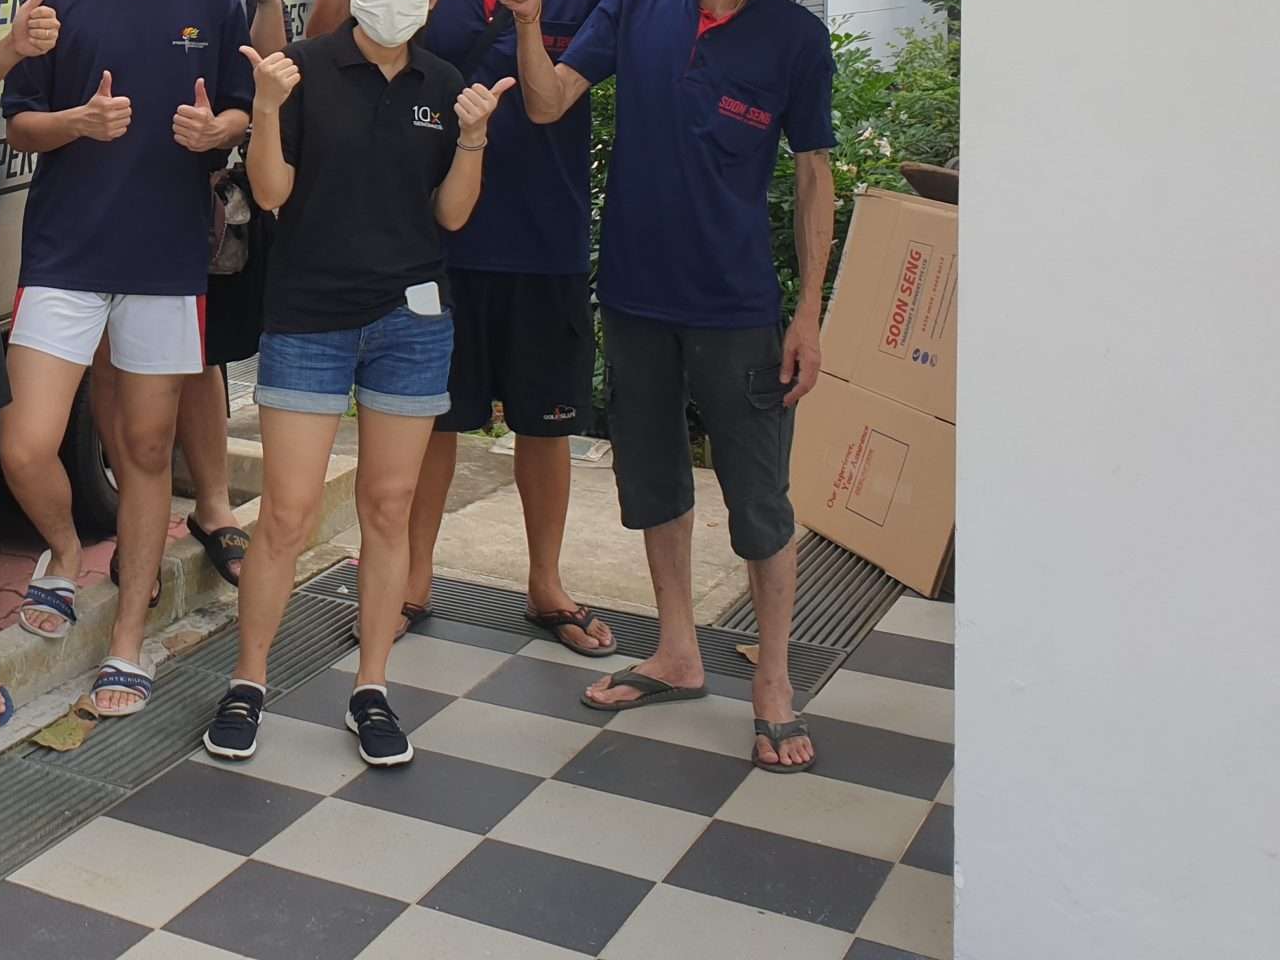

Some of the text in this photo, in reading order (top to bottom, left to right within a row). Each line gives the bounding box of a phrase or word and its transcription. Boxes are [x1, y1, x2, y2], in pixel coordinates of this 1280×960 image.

[719, 95, 747, 114] SOON
[412, 105, 441, 124] 10x
[885, 248, 922, 348] SOON SENG
